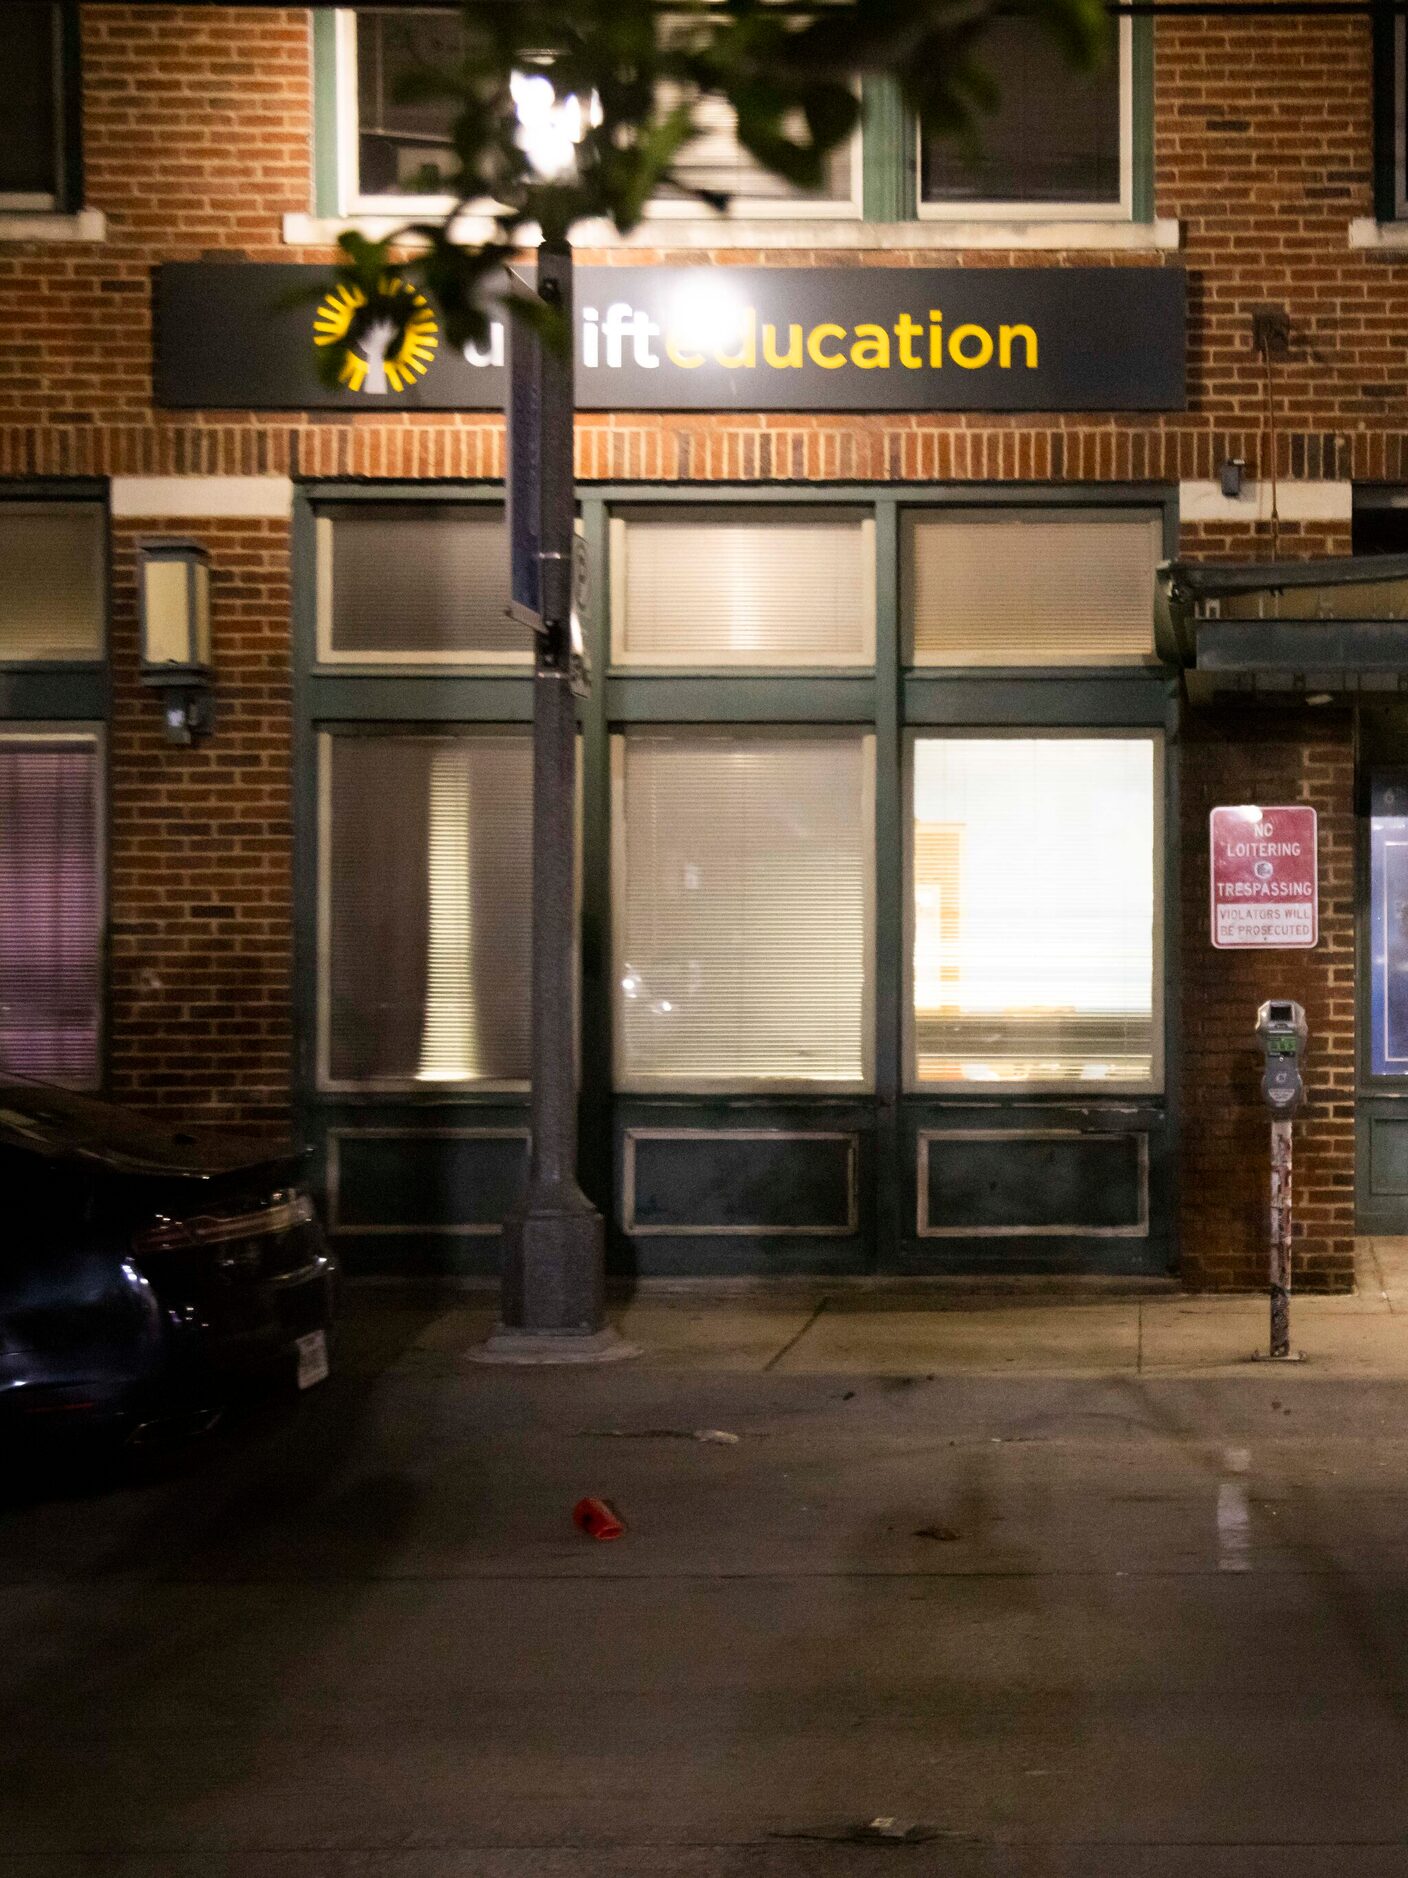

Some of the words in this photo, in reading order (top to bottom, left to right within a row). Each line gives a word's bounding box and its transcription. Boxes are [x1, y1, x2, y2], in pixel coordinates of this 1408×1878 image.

[1253, 823, 1274, 837] NO
[1227, 843, 1302, 857] LOITERING
[1217, 882, 1313, 897] TRESPASSING
[1219, 909, 1281, 920] VIOLATORS
[1284, 909, 1311, 919] WILL
[1220, 925, 1234, 936] BE
[1237, 925, 1310, 936] PROSECUTED
